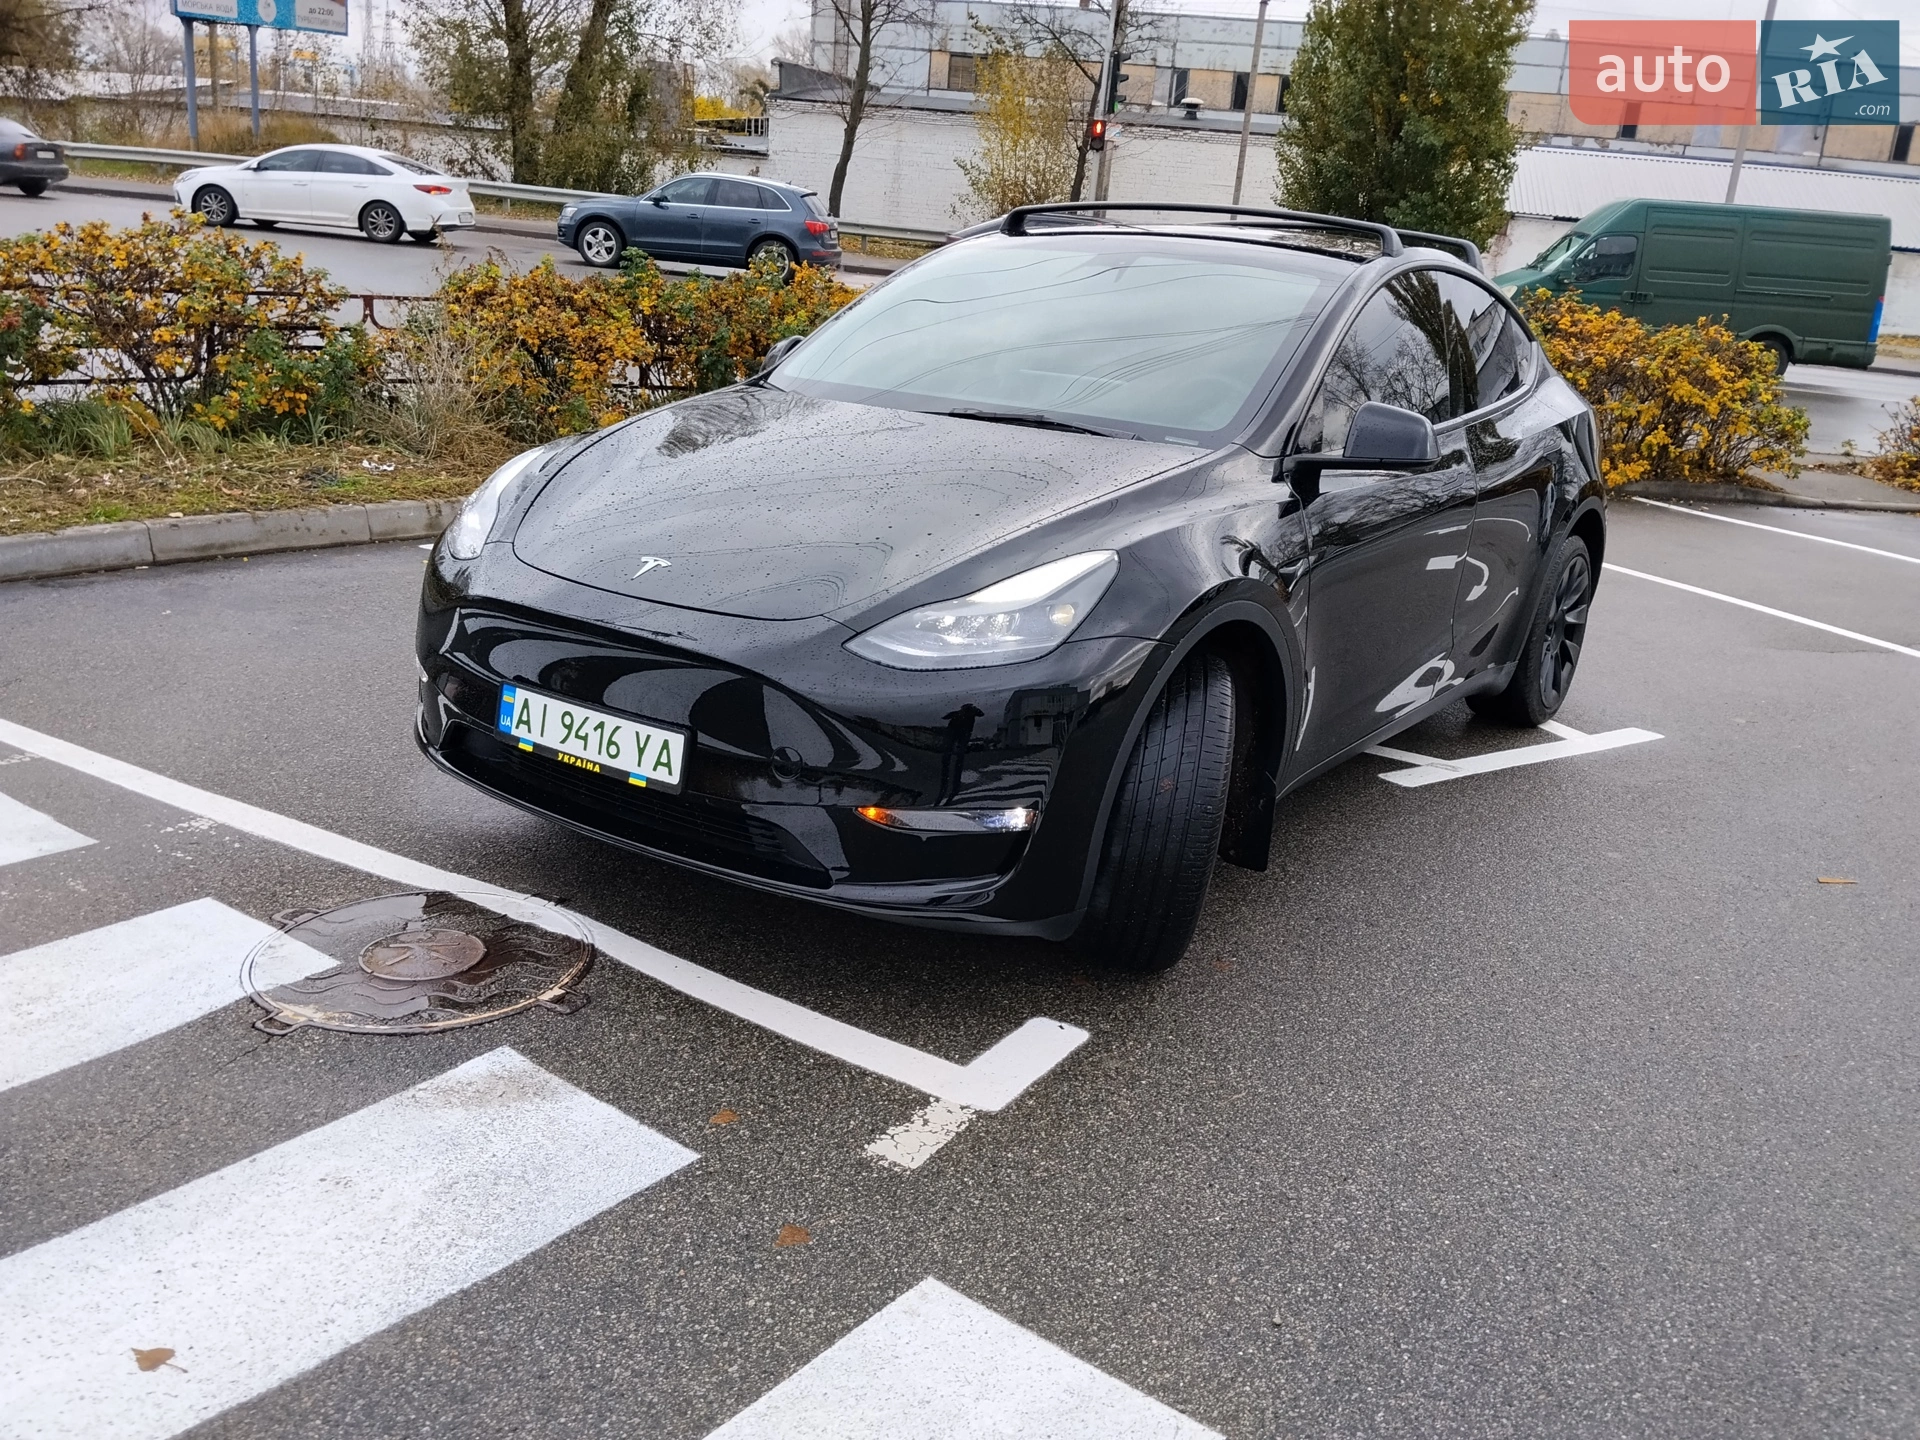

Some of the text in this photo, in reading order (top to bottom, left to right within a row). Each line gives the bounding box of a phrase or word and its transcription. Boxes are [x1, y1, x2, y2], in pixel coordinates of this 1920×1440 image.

[182, 0, 234, 13] МОРСЬКА ВОДА
[317, 7, 334, 16] 22:00
[500, 714, 511, 728] UA
[515, 698, 673, 776] AI 9416 YA
[557, 752, 600, 773] УКРАЇНА
